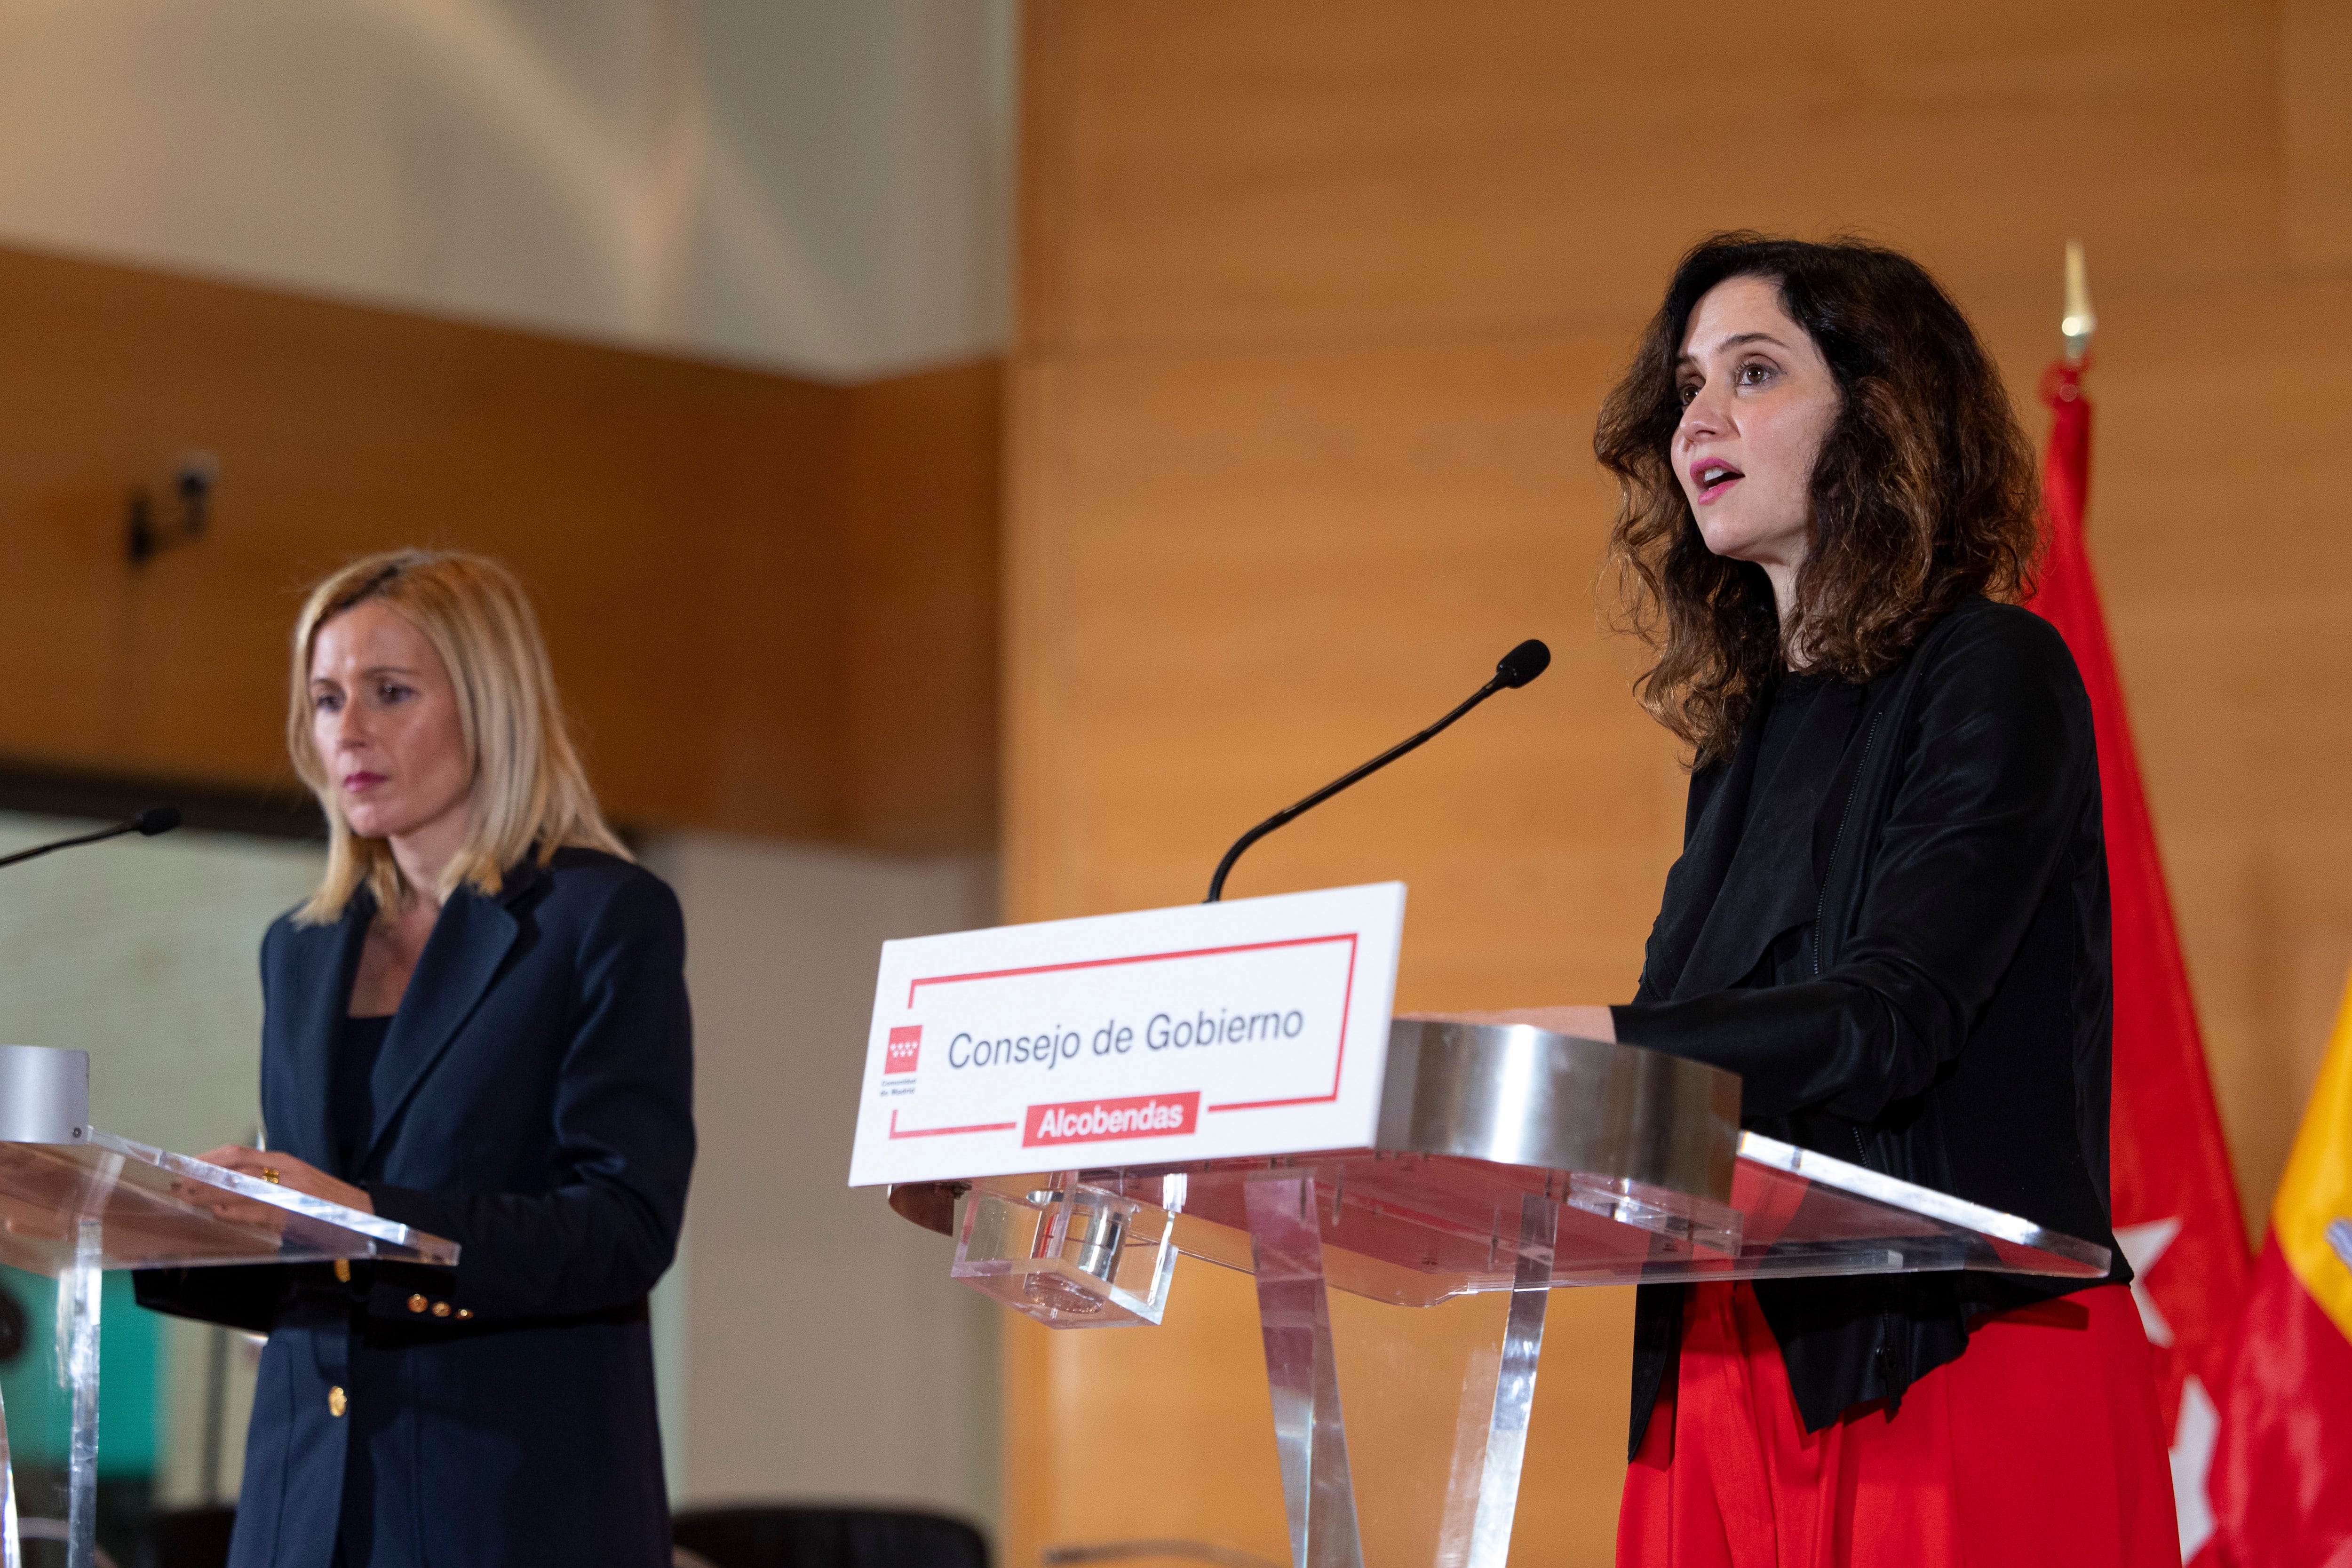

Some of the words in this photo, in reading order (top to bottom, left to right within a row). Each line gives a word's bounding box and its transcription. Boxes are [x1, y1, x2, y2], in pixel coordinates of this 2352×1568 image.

[948, 1025, 1081, 1070] Consejo
[1092, 1019, 1134, 1056] de
[1146, 1008, 1304, 1051] Gobierno
[1037, 1100, 1184, 1139] Alcobendas
